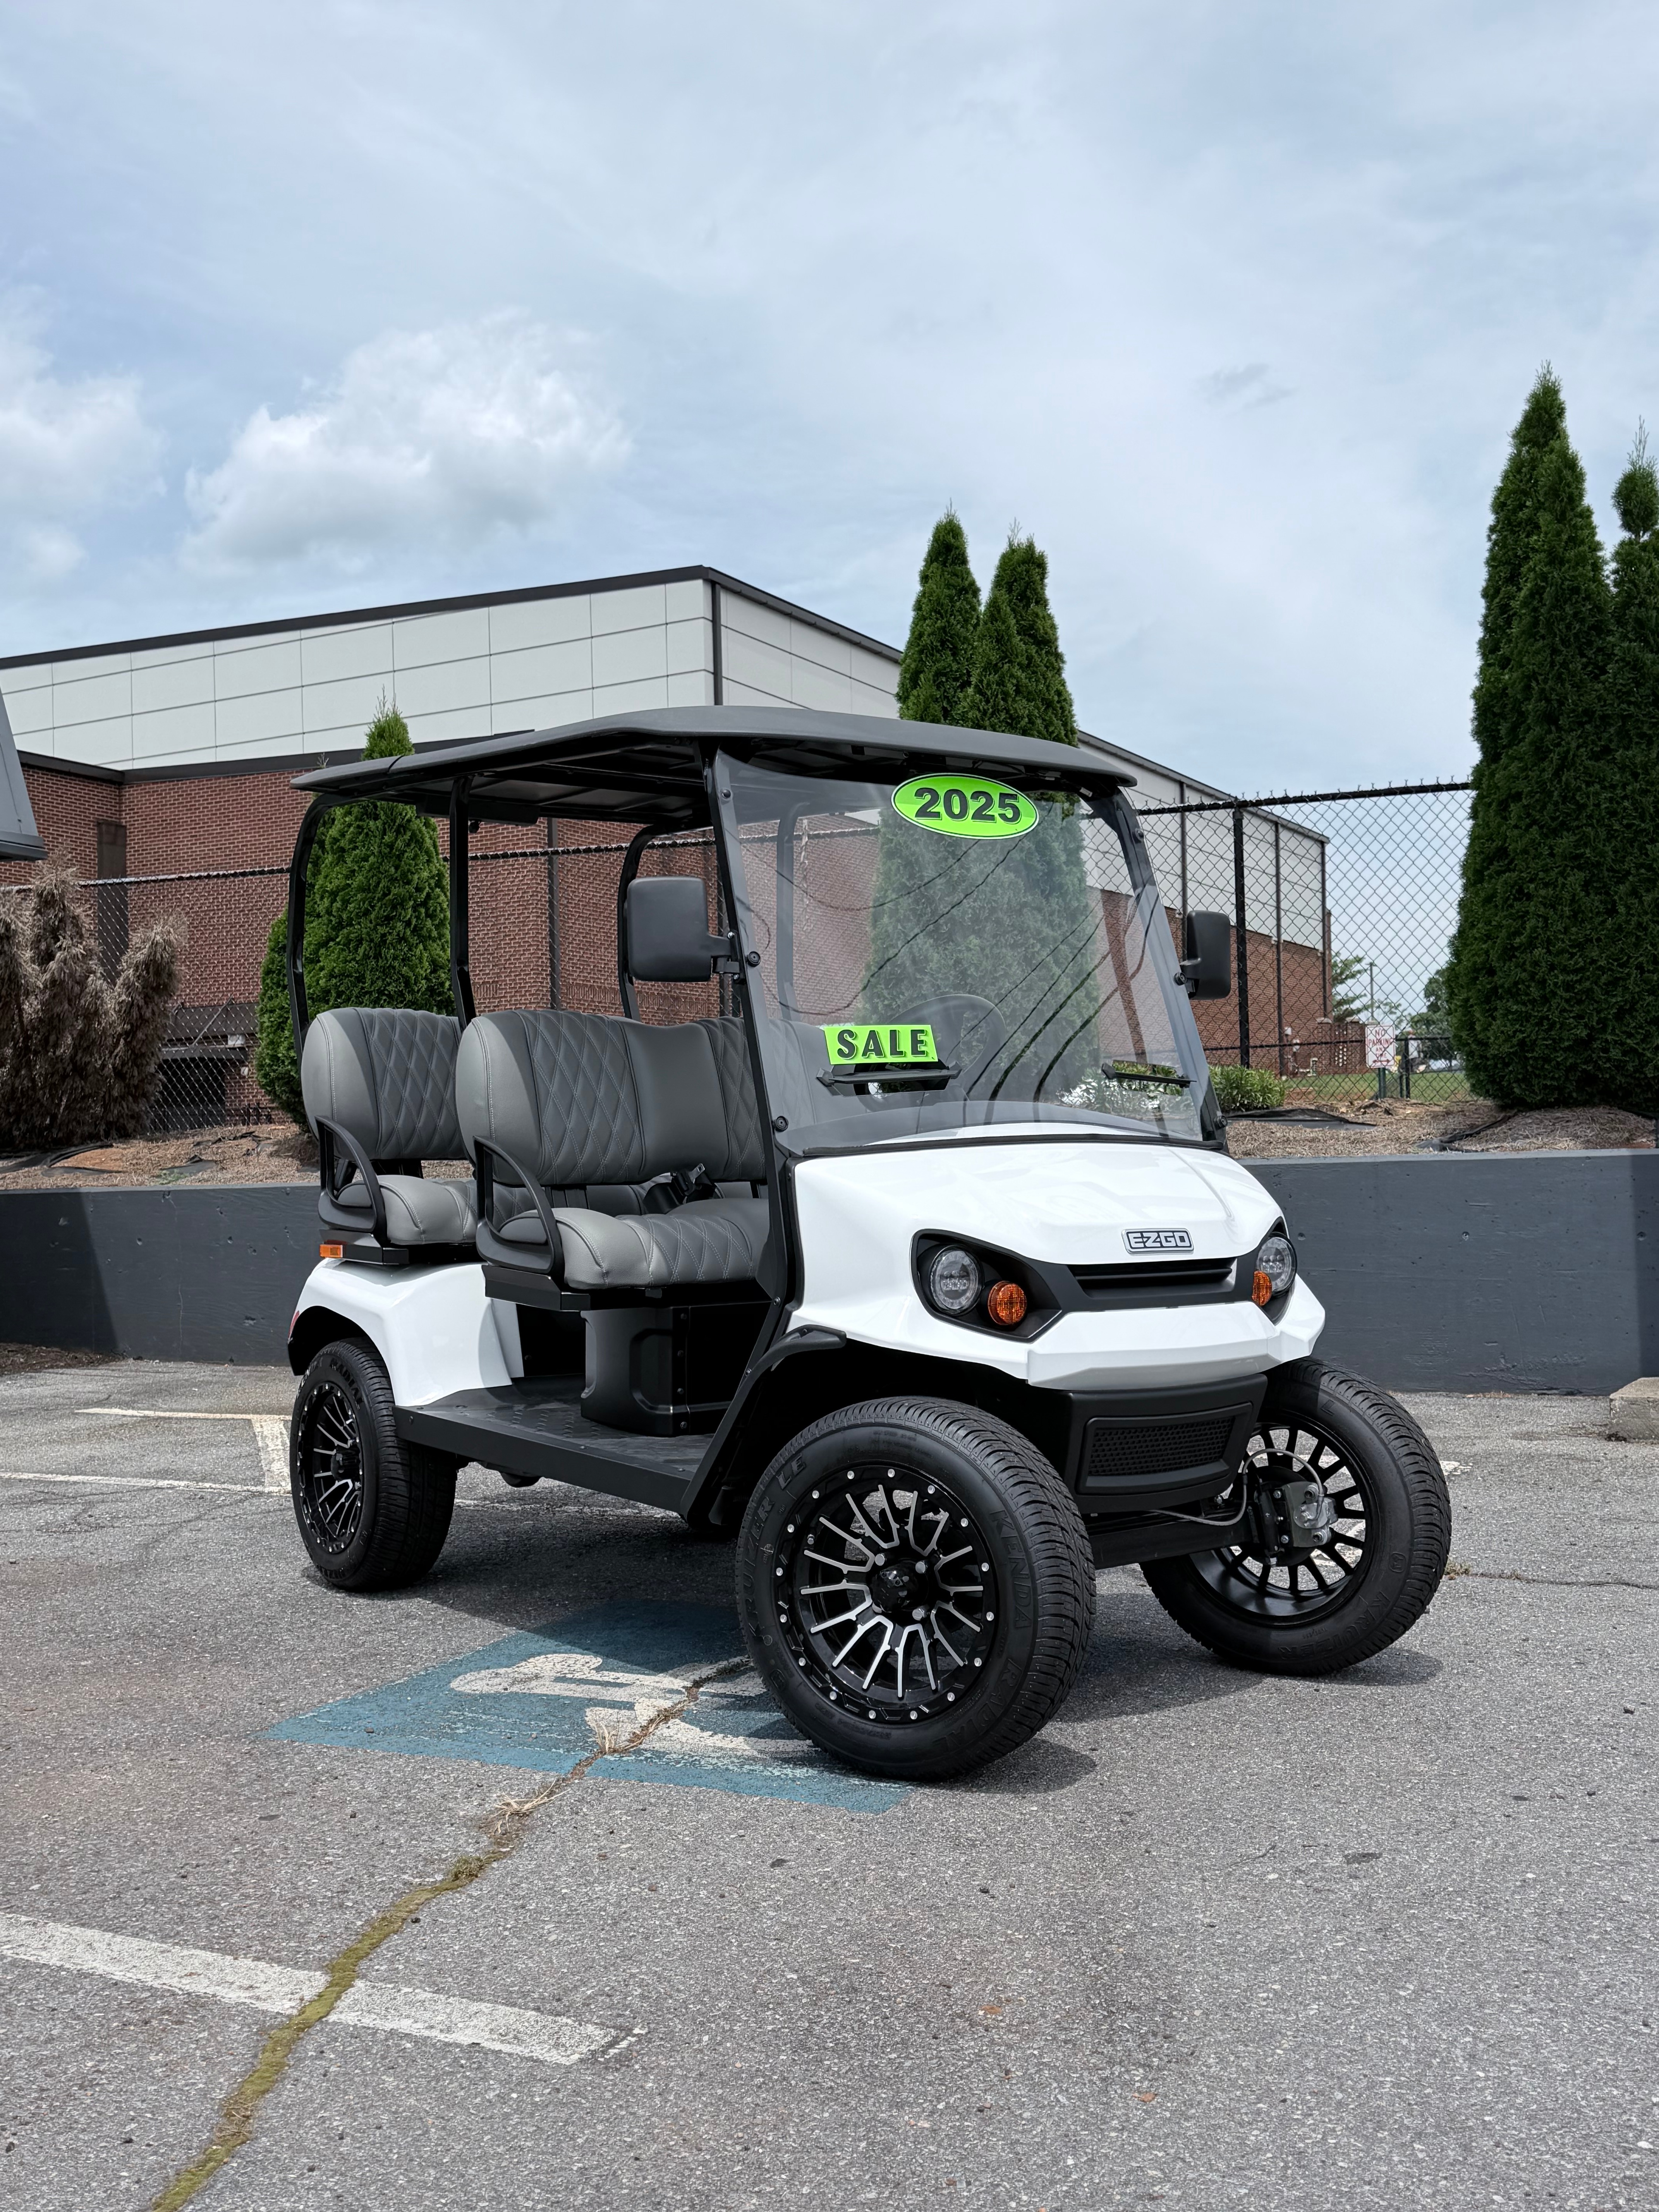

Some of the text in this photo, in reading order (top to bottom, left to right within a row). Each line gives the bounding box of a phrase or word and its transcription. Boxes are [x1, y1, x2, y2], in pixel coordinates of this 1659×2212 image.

[914, 788, 1022, 824] 2025
[837, 1029, 926, 1060] SALE
[1375, 1029, 1386, 1037] NO
[775, 1452, 807, 1490] LE
[988, 1509, 1032, 1629] KENDA
